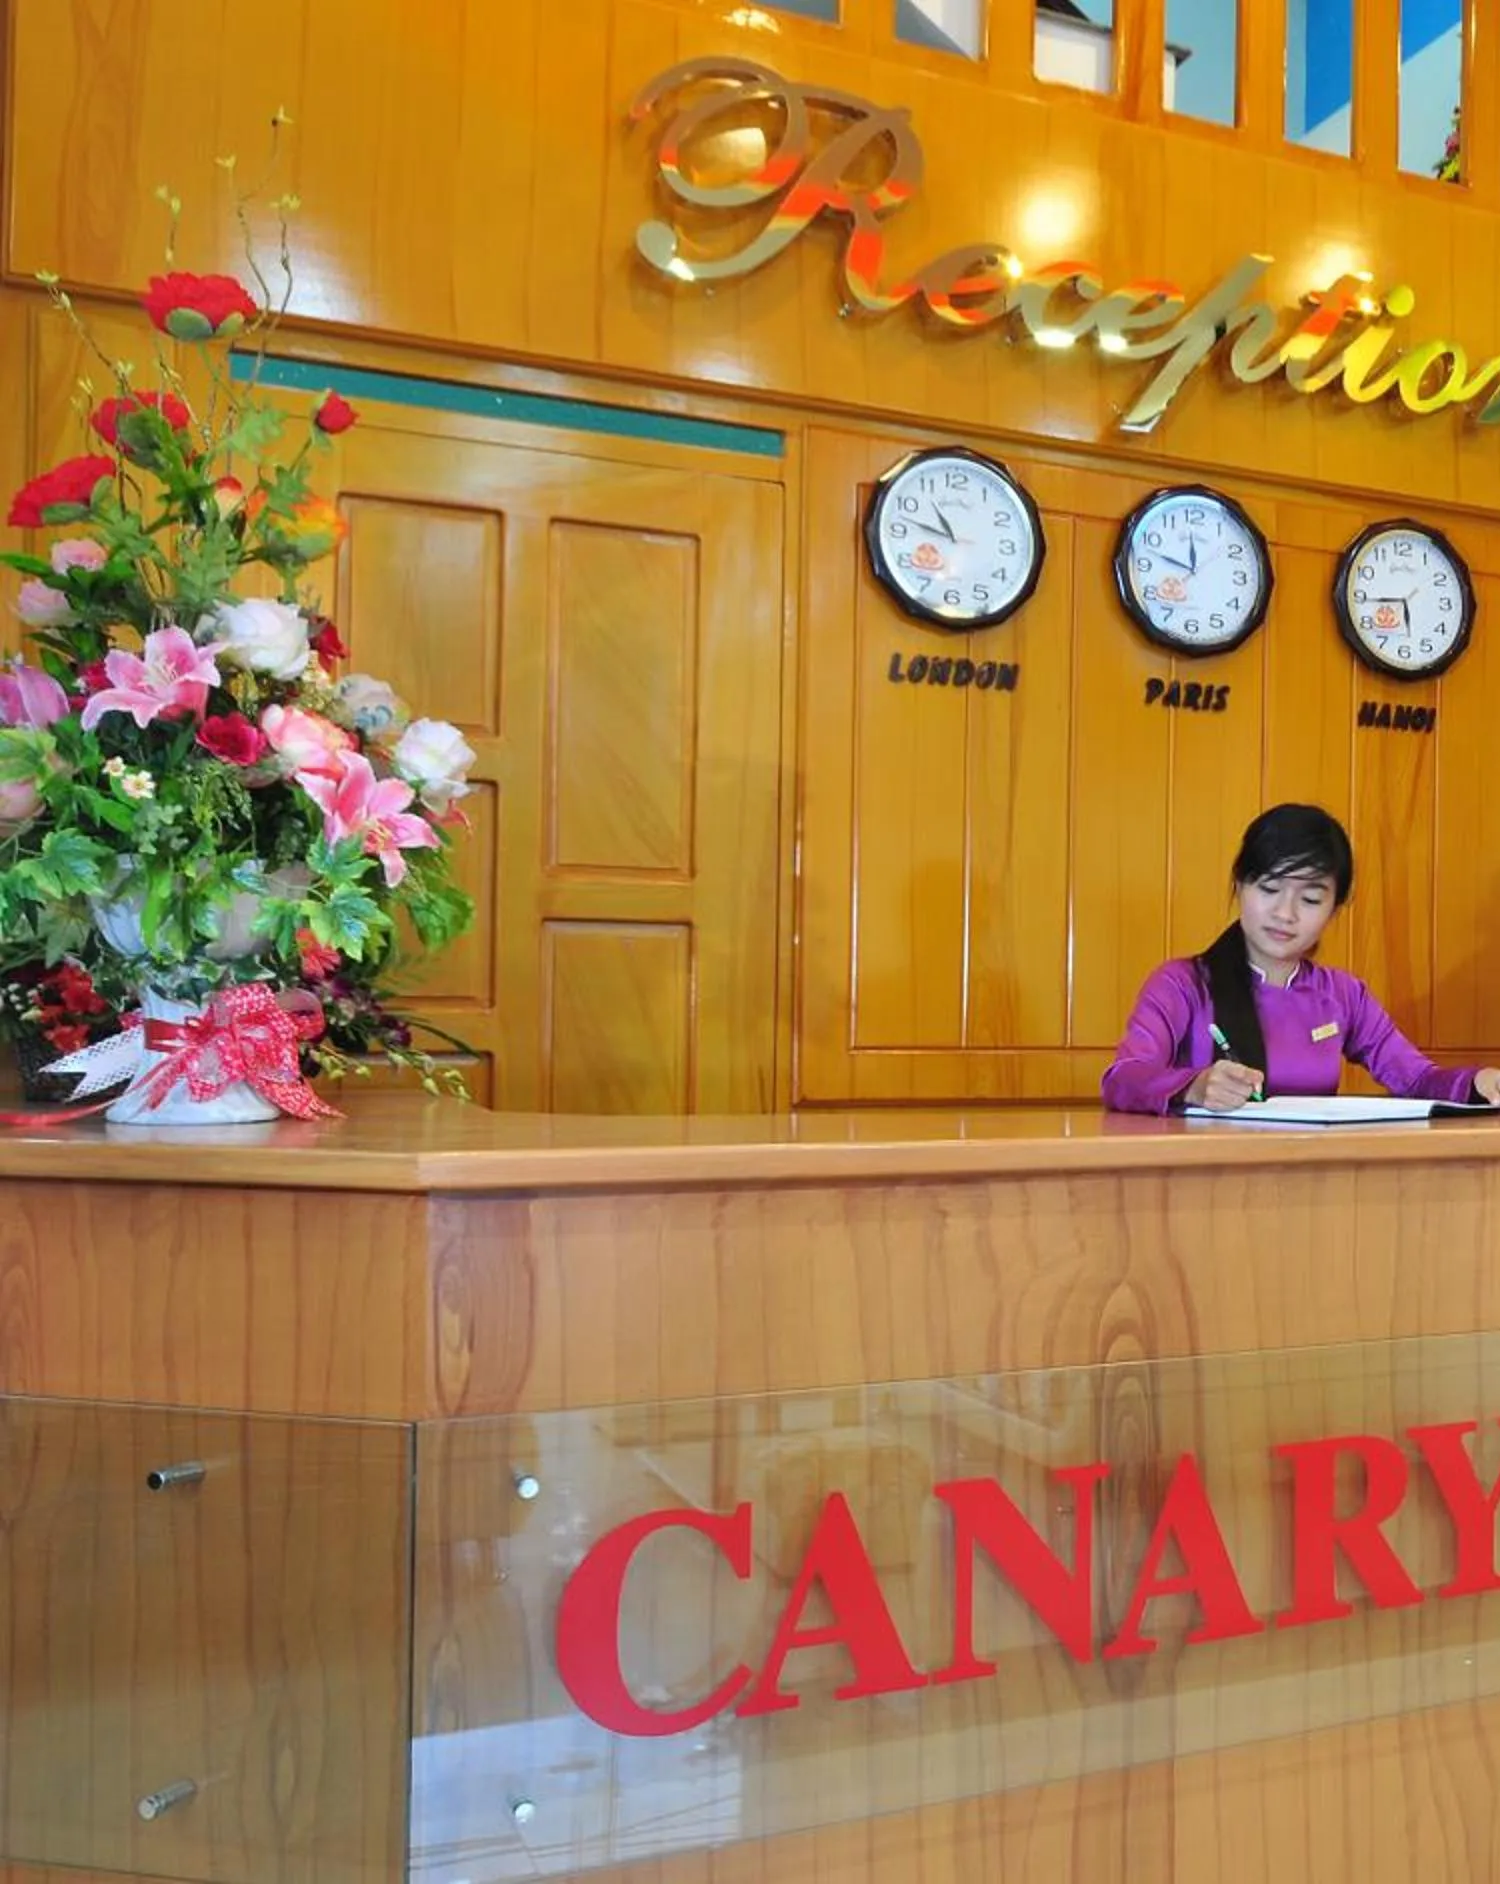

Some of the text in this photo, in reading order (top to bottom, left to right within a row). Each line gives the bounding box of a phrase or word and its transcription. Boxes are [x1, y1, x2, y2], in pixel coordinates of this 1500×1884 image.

[920, 478, 934, 493] 11
[946, 472, 969, 490] 12
[898, 496, 918, 512] 10
[994, 512, 1010, 528] 2
[1163, 514, 1175, 529] 11
[1185, 509, 1204, 525] 12
[890, 523, 907, 538] 9
[1142, 532, 1161, 546] 10
[999, 540, 1015, 555] 3
[1228, 544, 1243, 560] 2
[1394, 541, 1412, 556] 12
[1137, 558, 1152, 572] 9
[992, 568, 1007, 582] 4
[1233, 571, 1247, 586] 3
[1358, 566, 1374, 580] 10
[1434, 573, 1446, 586] 2
[918, 577, 931, 592] 7
[973, 584, 989, 600] 5
[944, 589, 960, 605] 6
[1144, 586, 1156, 600] 8
[1354, 590, 1366, 603] 9
[1226, 597, 1240, 610] 4
[1439, 597, 1452, 611] 3
[1161, 607, 1173, 622] 7
[1210, 614, 1224, 629] 5
[1184, 620, 1199, 634] 6
[1360, 616, 1373, 629] 8
[1434, 622, 1445, 635] 4
[1377, 635, 1388, 649] 7
[1420, 639, 1432, 652] 5
[1398, 646, 1411, 658] 6
[888, 652, 1019, 692] LONDON
[1144, 678, 1230, 712] PARIS
